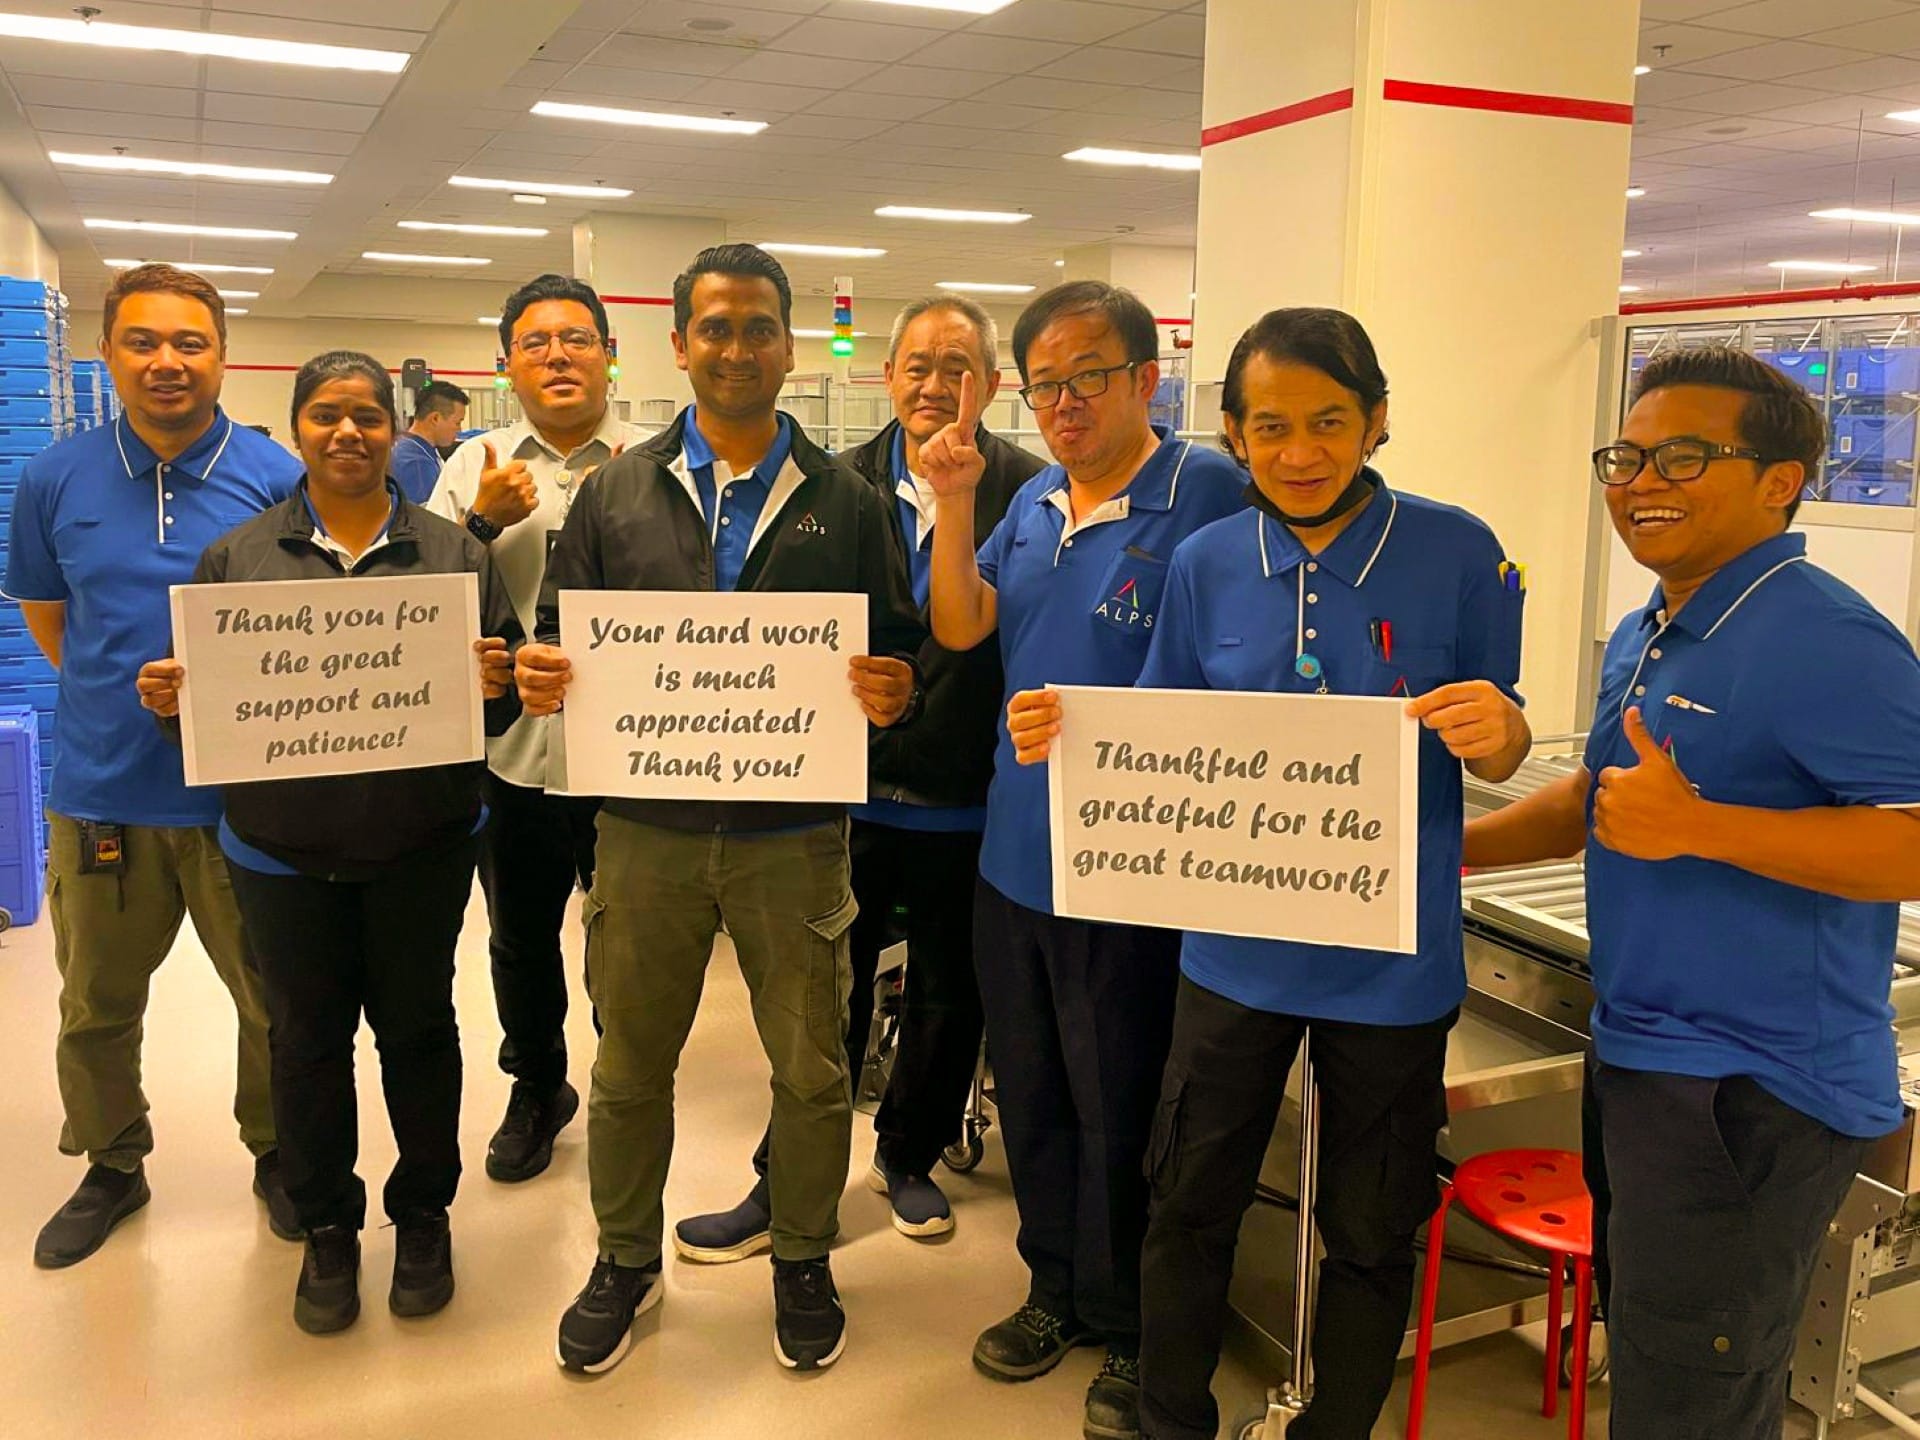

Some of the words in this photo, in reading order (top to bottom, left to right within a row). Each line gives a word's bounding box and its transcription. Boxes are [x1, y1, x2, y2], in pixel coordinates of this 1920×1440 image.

[796, 522, 826, 535] ALPS
[216, 606, 313, 635] Thank
[325, 609, 383, 634] you
[396, 601, 438, 630] for
[1095, 601, 1153, 628] ALPS
[590, 618, 664, 649] Your
[677, 618, 749, 643] hard
[763, 620, 838, 651] work
[261, 650, 308, 675] the
[321, 643, 402, 678] great
[656, 664, 680, 691] is
[693, 664, 775, 691] much
[236, 688, 359, 721] support
[372, 681, 430, 709] and
[616, 708, 815, 738] appreciated!
[267, 726, 407, 763] patience!
[629, 752, 721, 782] Thank
[734, 754, 804, 782] you!
[1095, 741, 1267, 783] Thankful
[1283, 754, 1361, 785] and
[1080, 796, 1235, 833] grateful
[1251, 803, 1305, 838] for
[1321, 808, 1380, 841] the
[1073, 849, 1165, 876] great
[1181, 851, 1389, 902] teamwork!
